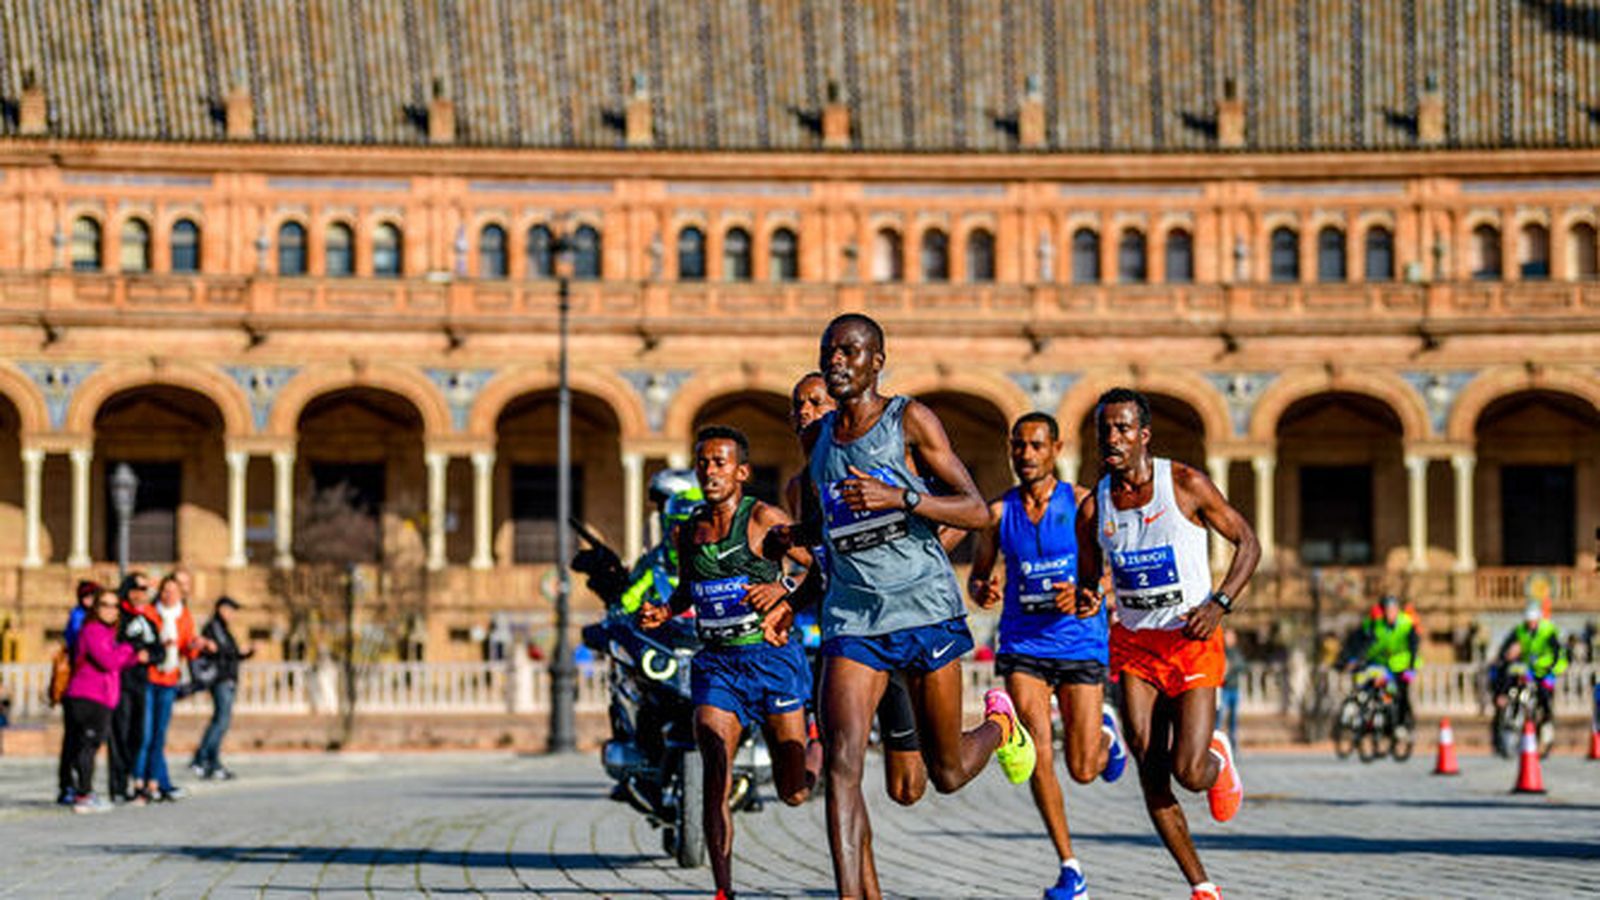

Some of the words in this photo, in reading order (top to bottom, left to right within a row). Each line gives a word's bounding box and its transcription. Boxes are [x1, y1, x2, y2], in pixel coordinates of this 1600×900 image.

[1127, 551, 1167, 566] ZURICH
[1042, 578, 1052, 591] 6
[1137, 572, 1150, 587] 2
[714, 602, 725, 617] 5
